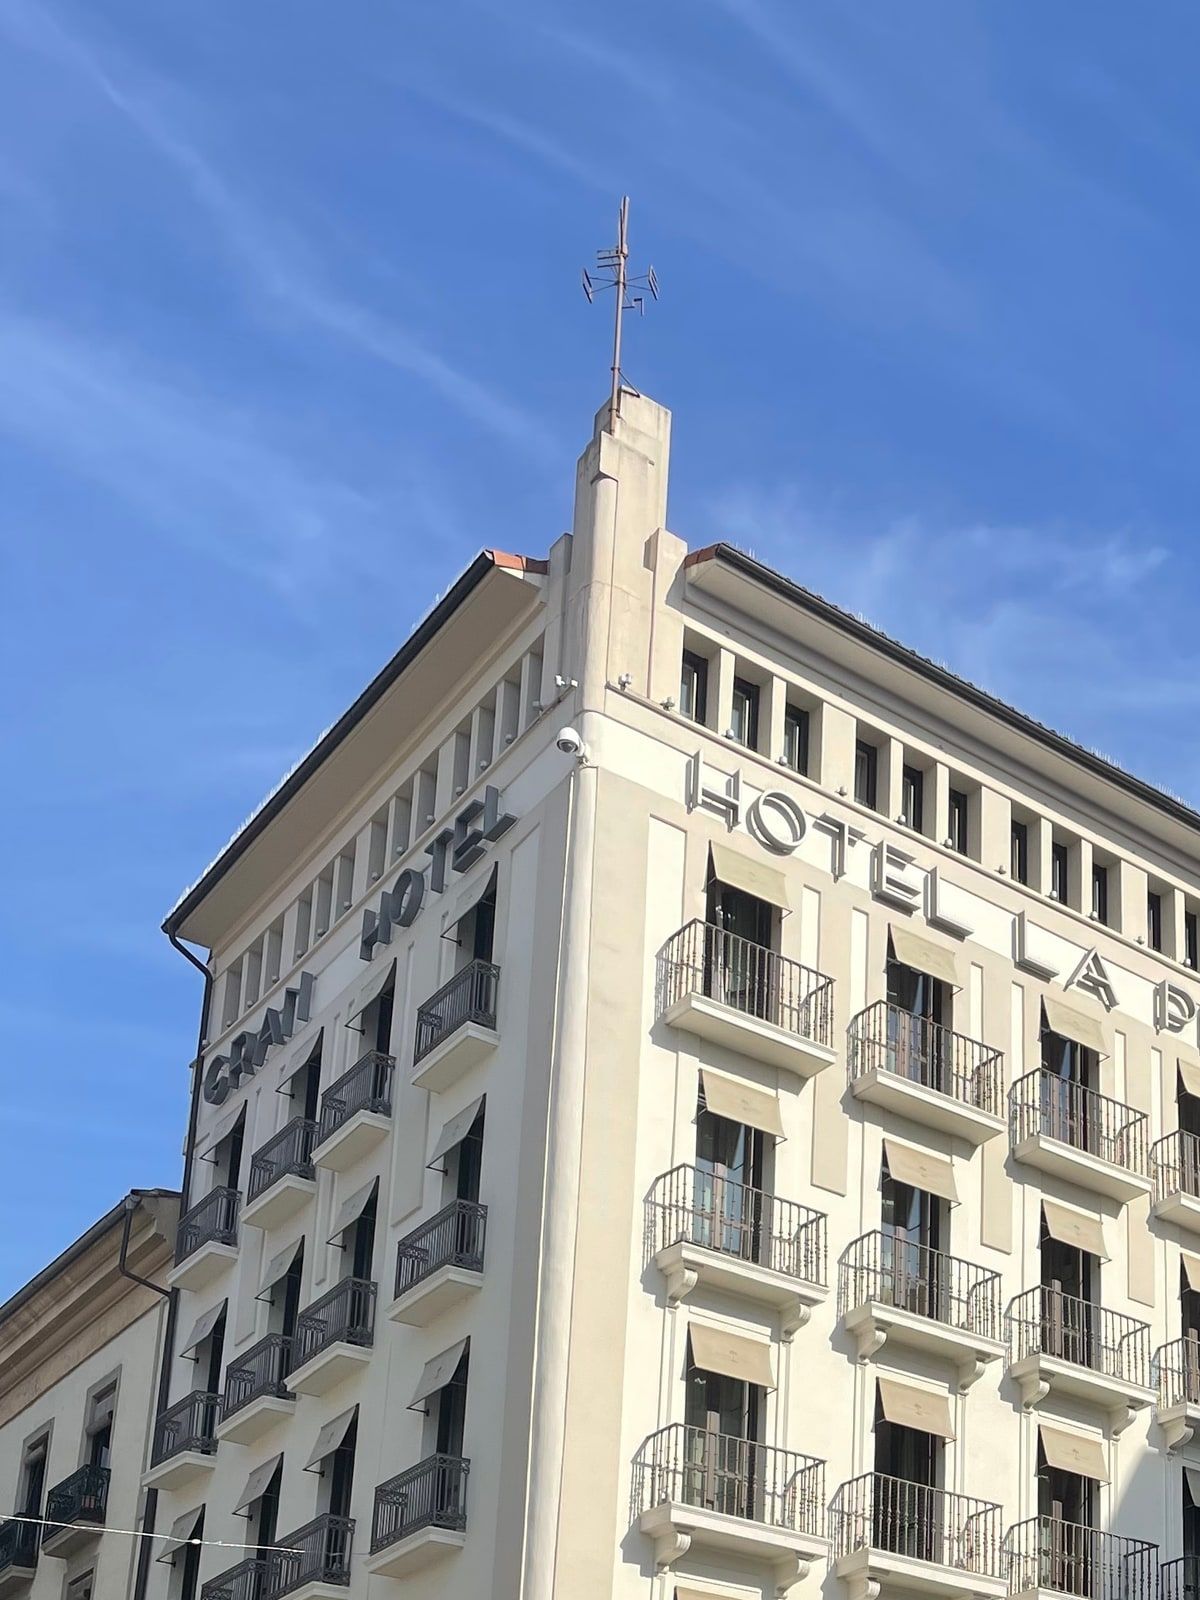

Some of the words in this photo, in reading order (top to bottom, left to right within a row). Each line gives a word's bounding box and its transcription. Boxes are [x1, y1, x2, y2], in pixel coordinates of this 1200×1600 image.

[203, 971, 314, 1105] GRAN
[360, 785, 518, 961] HOTEL
[686, 750, 974, 942] HOTEL
[1012, 910, 1119, 1012] LA
